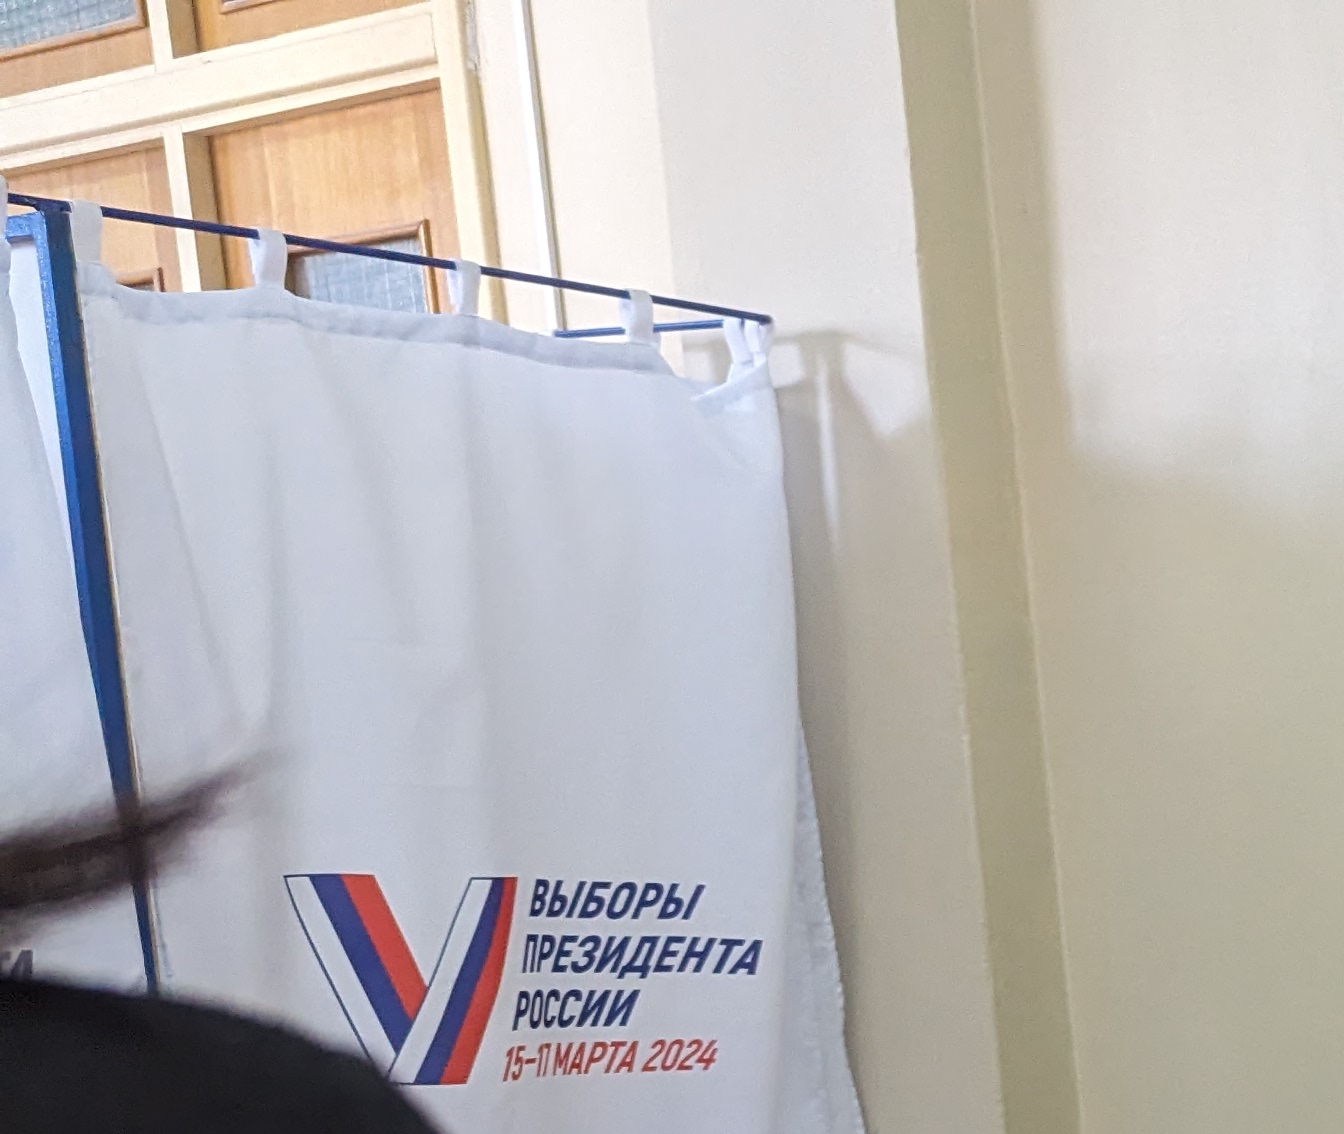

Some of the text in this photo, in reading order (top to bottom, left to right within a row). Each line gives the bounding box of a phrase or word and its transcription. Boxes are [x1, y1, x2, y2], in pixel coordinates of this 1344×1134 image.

[529, 878, 706, 921] ВЫБОРЫ
[521, 933, 764, 980] ПРЕЗИДЕНТА
[511, 988, 641, 1032] РОССИИ
[552, 1040, 640, 1077] МАРТА
[641, 1038, 719, 1073] 2024
